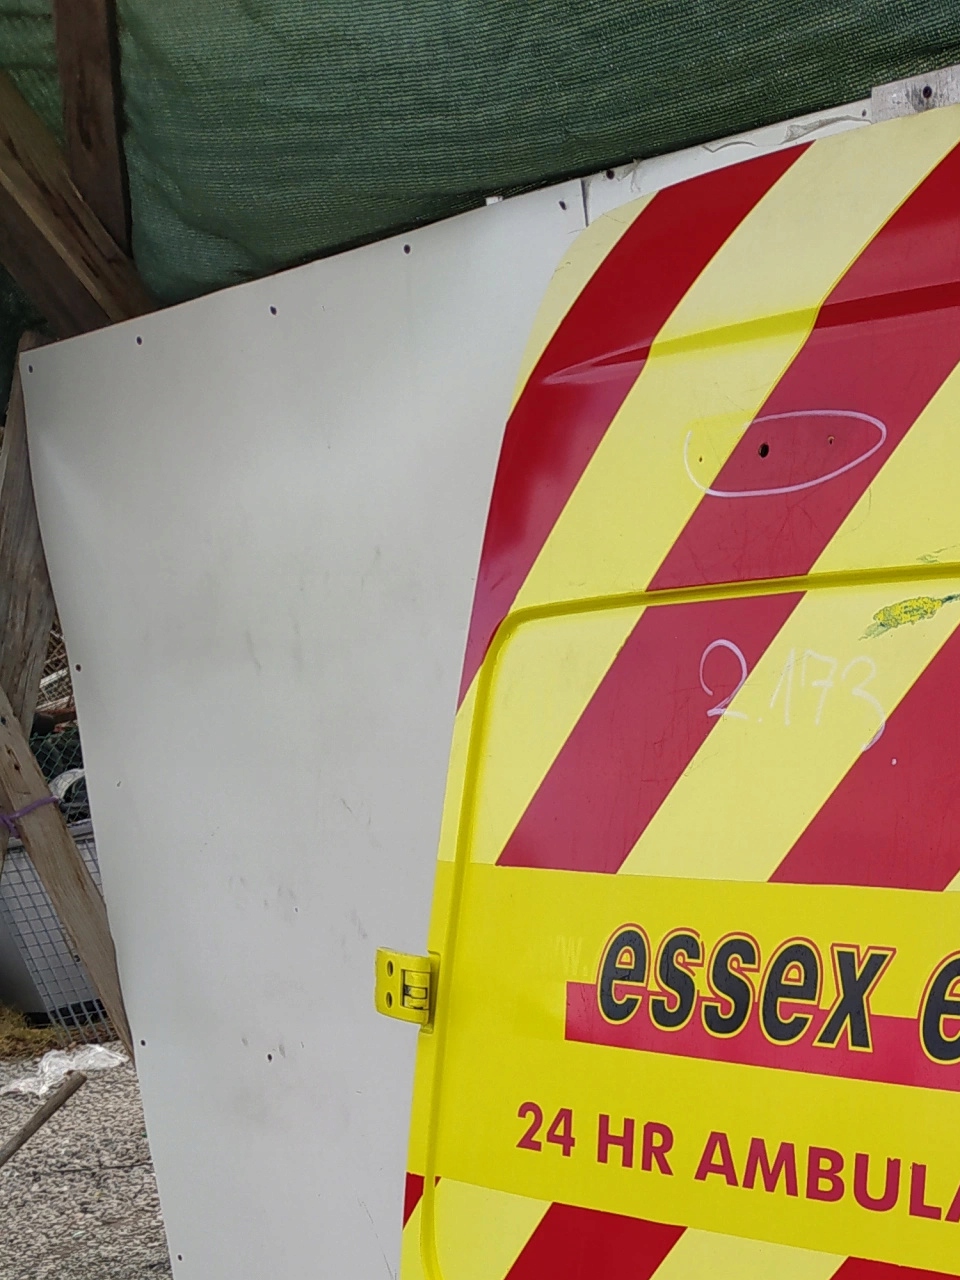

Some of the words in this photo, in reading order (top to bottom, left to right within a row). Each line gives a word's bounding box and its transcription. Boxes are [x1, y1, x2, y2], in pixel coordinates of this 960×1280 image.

[699, 638, 886, 753] 2.173
[596, 921, 898, 1054] essex
[516, 1101, 576, 1157] 24
[596, 1113, 674, 1176] HR
